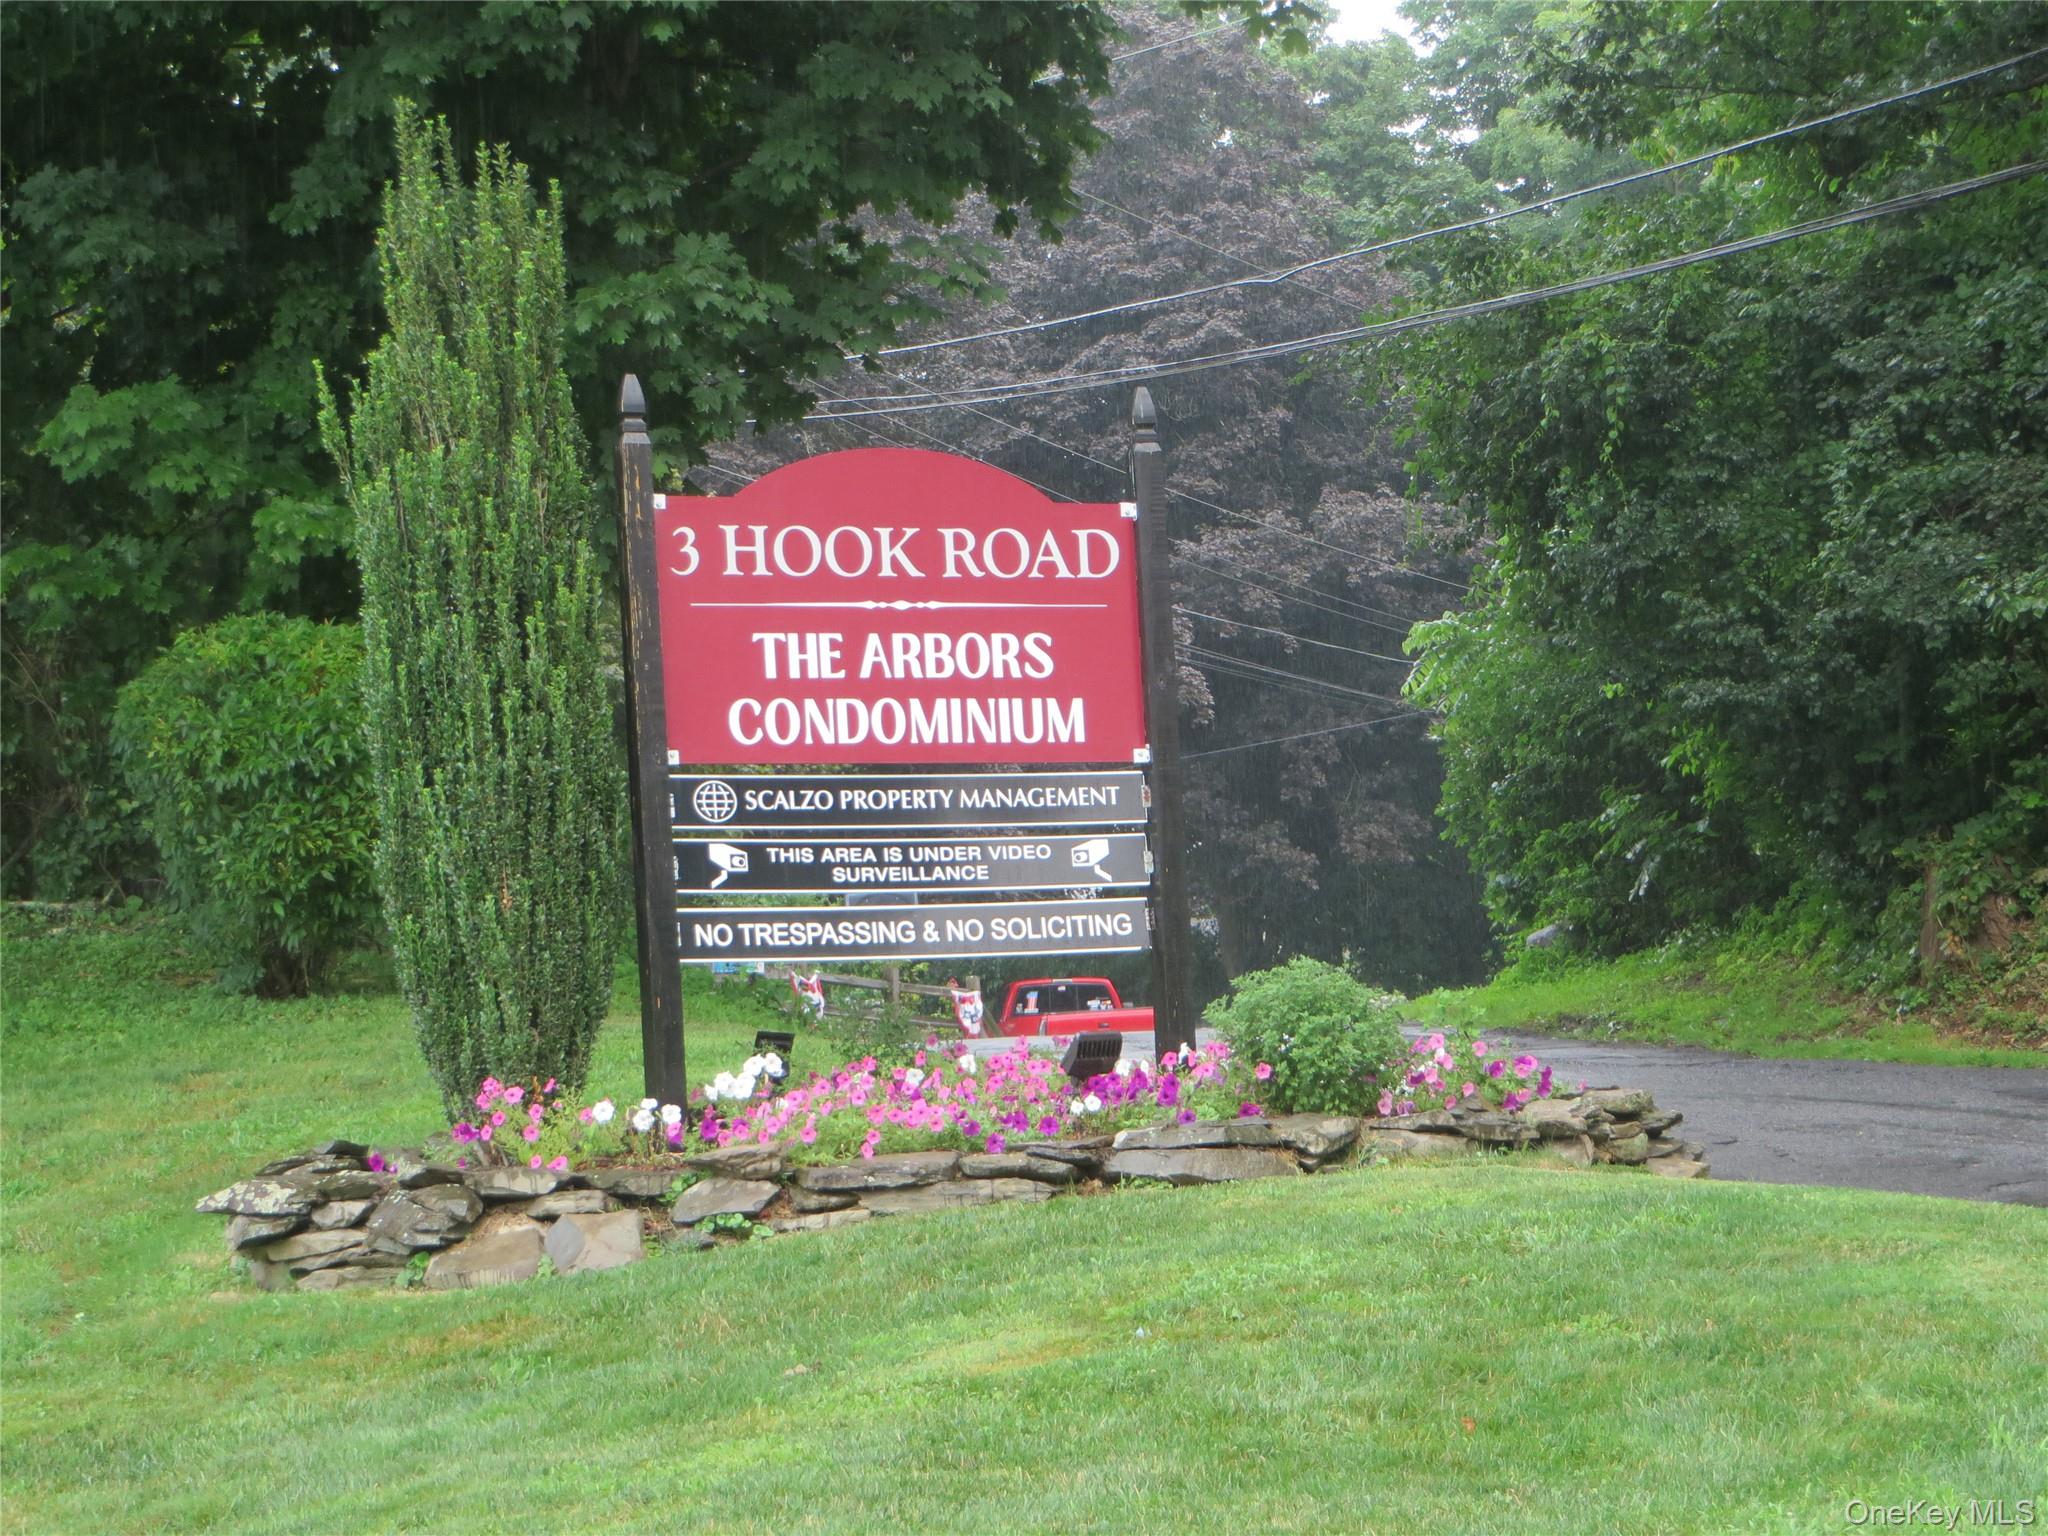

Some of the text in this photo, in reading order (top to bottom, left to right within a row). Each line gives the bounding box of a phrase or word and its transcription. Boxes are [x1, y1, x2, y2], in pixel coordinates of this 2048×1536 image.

[670, 525, 1120, 578] 3 HOOK ROAD
[752, 632, 1054, 679] THE ARBORS
[728, 697, 1085, 745] CONDOMINIUM
[745, 786, 1120, 810] SCALZO PROPERTY MANAGEMENT
[767, 844, 1051, 864] THIS AREA IS UNDER VIDEO
[832, 865, 990, 883] SURVEILLANCE
[694, 913, 1133, 947] NO TRESPASSING & NO SOLICITING
